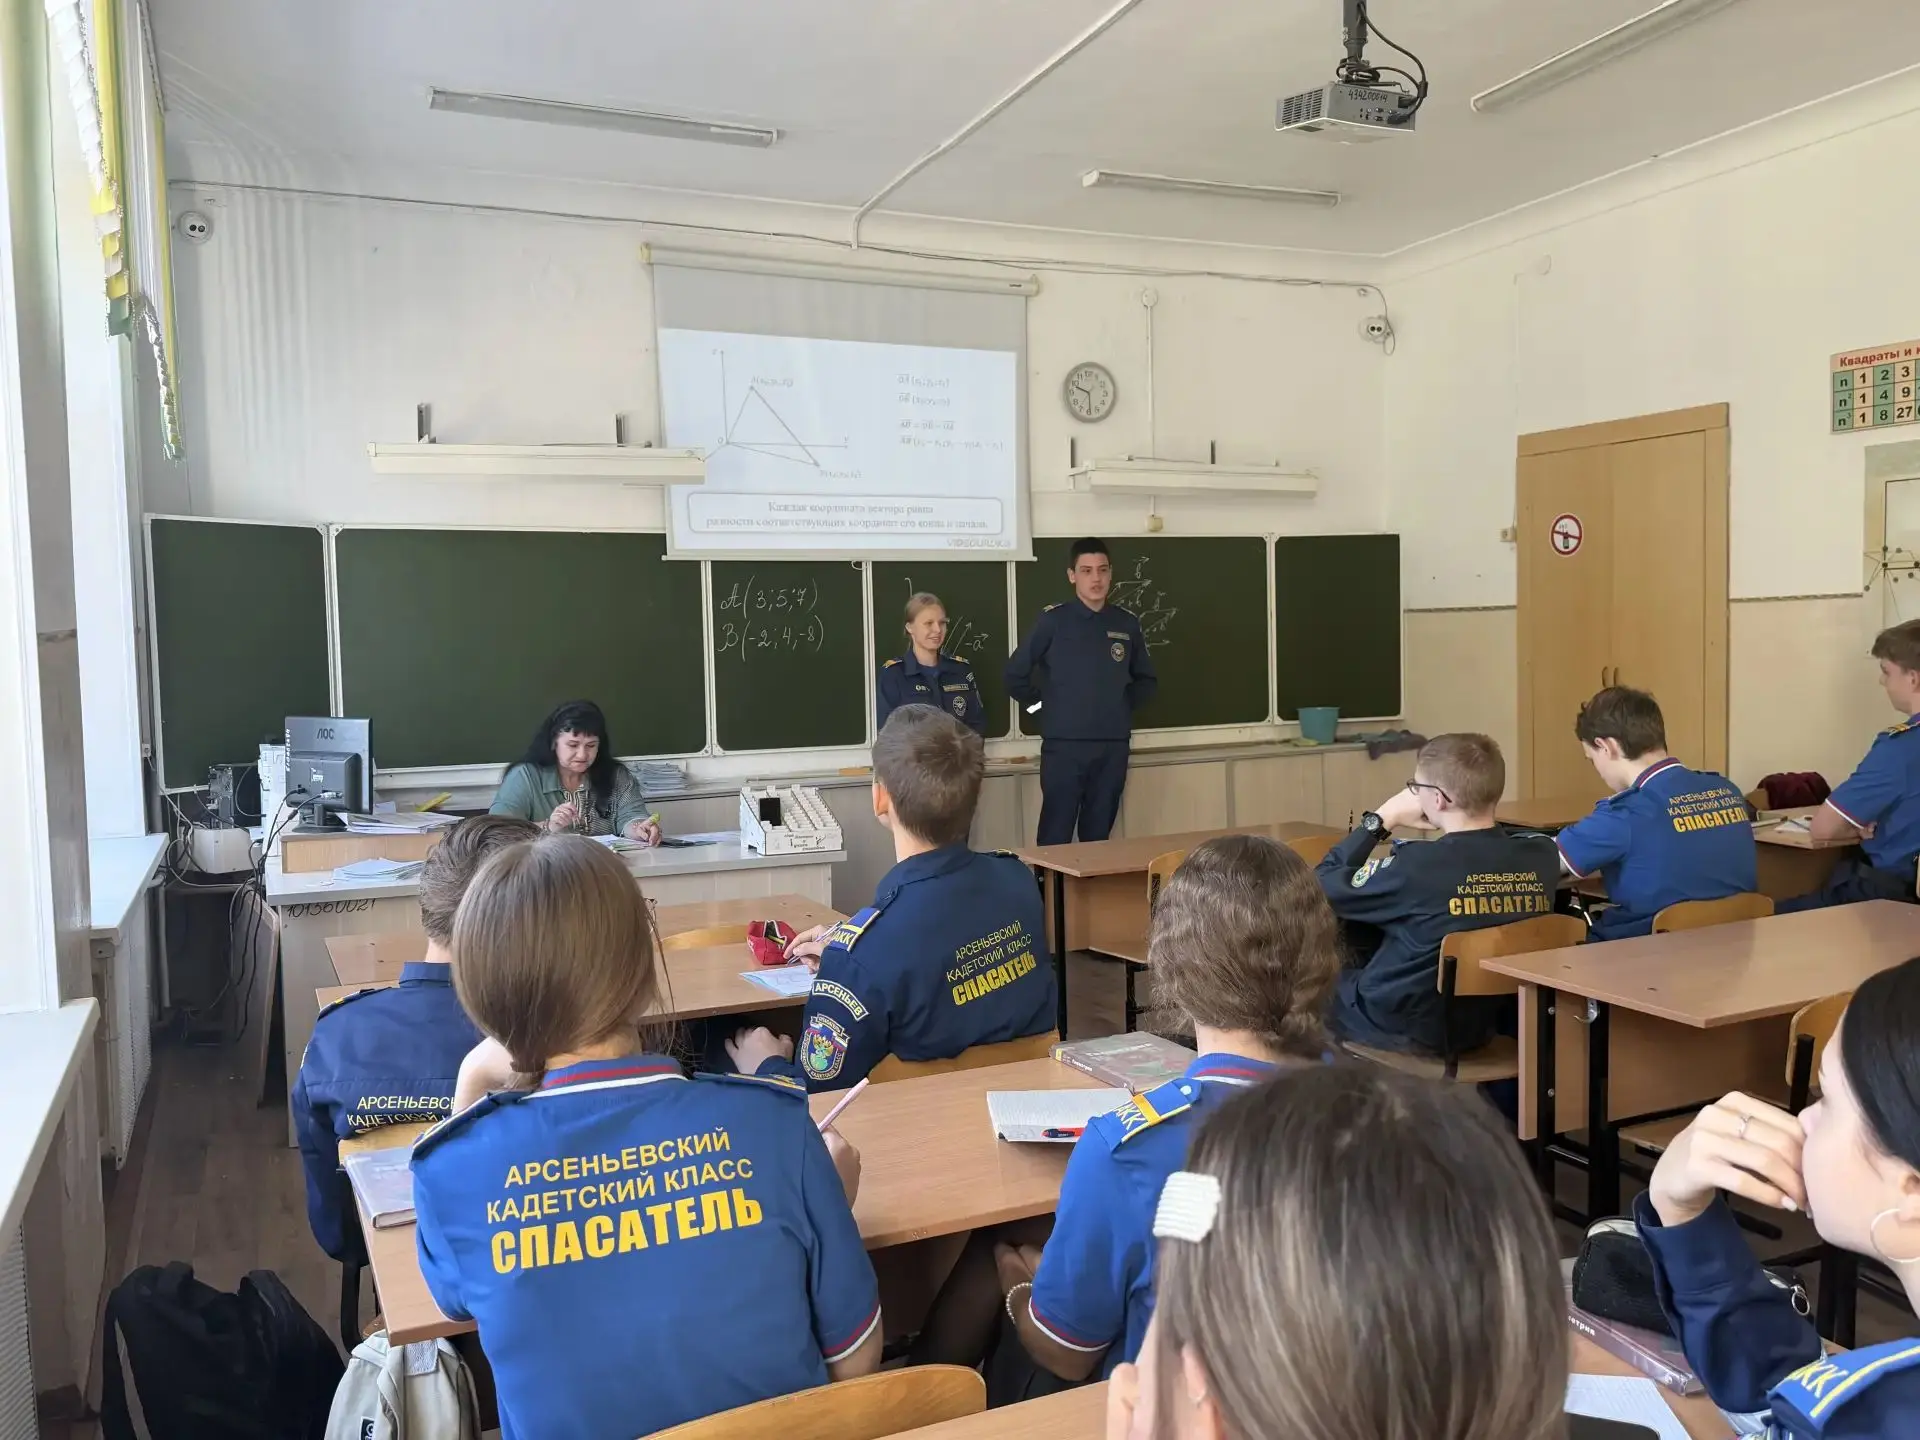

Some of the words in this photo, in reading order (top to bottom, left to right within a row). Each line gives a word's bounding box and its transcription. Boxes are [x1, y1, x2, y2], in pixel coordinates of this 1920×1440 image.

[1840, 350, 1900, 367] Квадраты
[1904, 348, 1912, 357] и
[1840, 378, 1848, 387] n
[1860, 372, 1866, 384] 1
[1881, 369, 1889, 380] 2
[1902, 366, 1910, 378] 3
[1860, 393, 1866, 404] 1
[1880, 390, 1888, 401] 4
[1902, 386, 1911, 398] 9
[1860, 412, 1866, 423] 1
[1880, 409, 1888, 421] 8
[1897, 406, 1913, 419] 27
[1667, 799, 1720, 816] КАДЕТСКИЙ
[1466, 872, 1537, 883] АРСЕНЬЕВСКИЙ
[1457, 883, 1514, 895] КАДЕТСКИЙ
[1515, 883, 1543, 892] КЛАСС
[1449, 895, 1550, 916] СПАСАТЕЛЬ
[956, 920, 1021, 962] АРСЕНЬЕВСКИЙ
[946, 946, 1004, 982] КАДЕТСКИЙ
[1006, 934, 1031, 954] КЛАСС
[953, 950, 1036, 1006] СПАСАТЕЛЬ
[815, 983, 863, 1016] АРСЕНЬЕВ
[357, 1096, 455, 1109] АРСЕНЬЕВС
[504, 1126, 731, 1189] АРСЕНЬЕВСКИЙ
[487, 1171, 655, 1224] КАДЕТСКИЙ
[664, 1159, 754, 1194] КЛАСС
[491, 1187, 764, 1274] СПАСАТЕЛЬ
